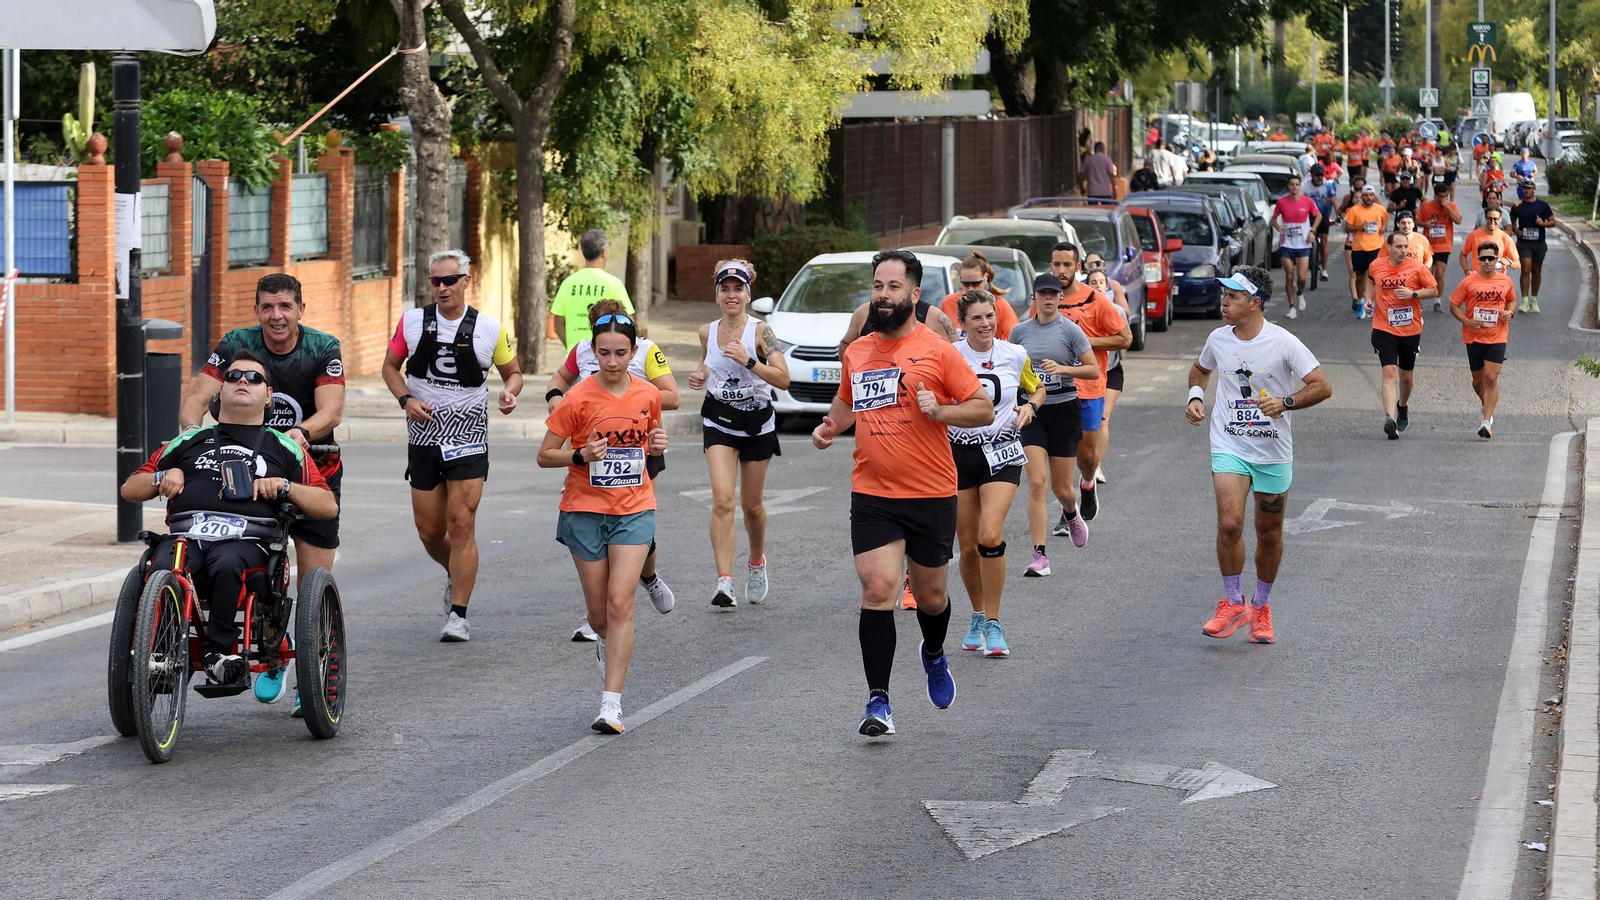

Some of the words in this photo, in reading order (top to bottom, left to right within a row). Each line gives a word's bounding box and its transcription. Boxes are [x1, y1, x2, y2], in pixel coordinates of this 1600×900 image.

[1381, 279, 1406, 287] XXIX
[571, 284, 606, 297] STAFF
[1476, 291, 1502, 299] XXIX
[1394, 313, 1408, 321] 603
[722, 390, 744, 399] 886
[863, 380, 886, 397] 794
[1236, 409, 1260, 421] 884
[994, 444, 1019, 462] 1036
[603, 461, 632, 475] 782
[200, 522, 230, 536] 670
